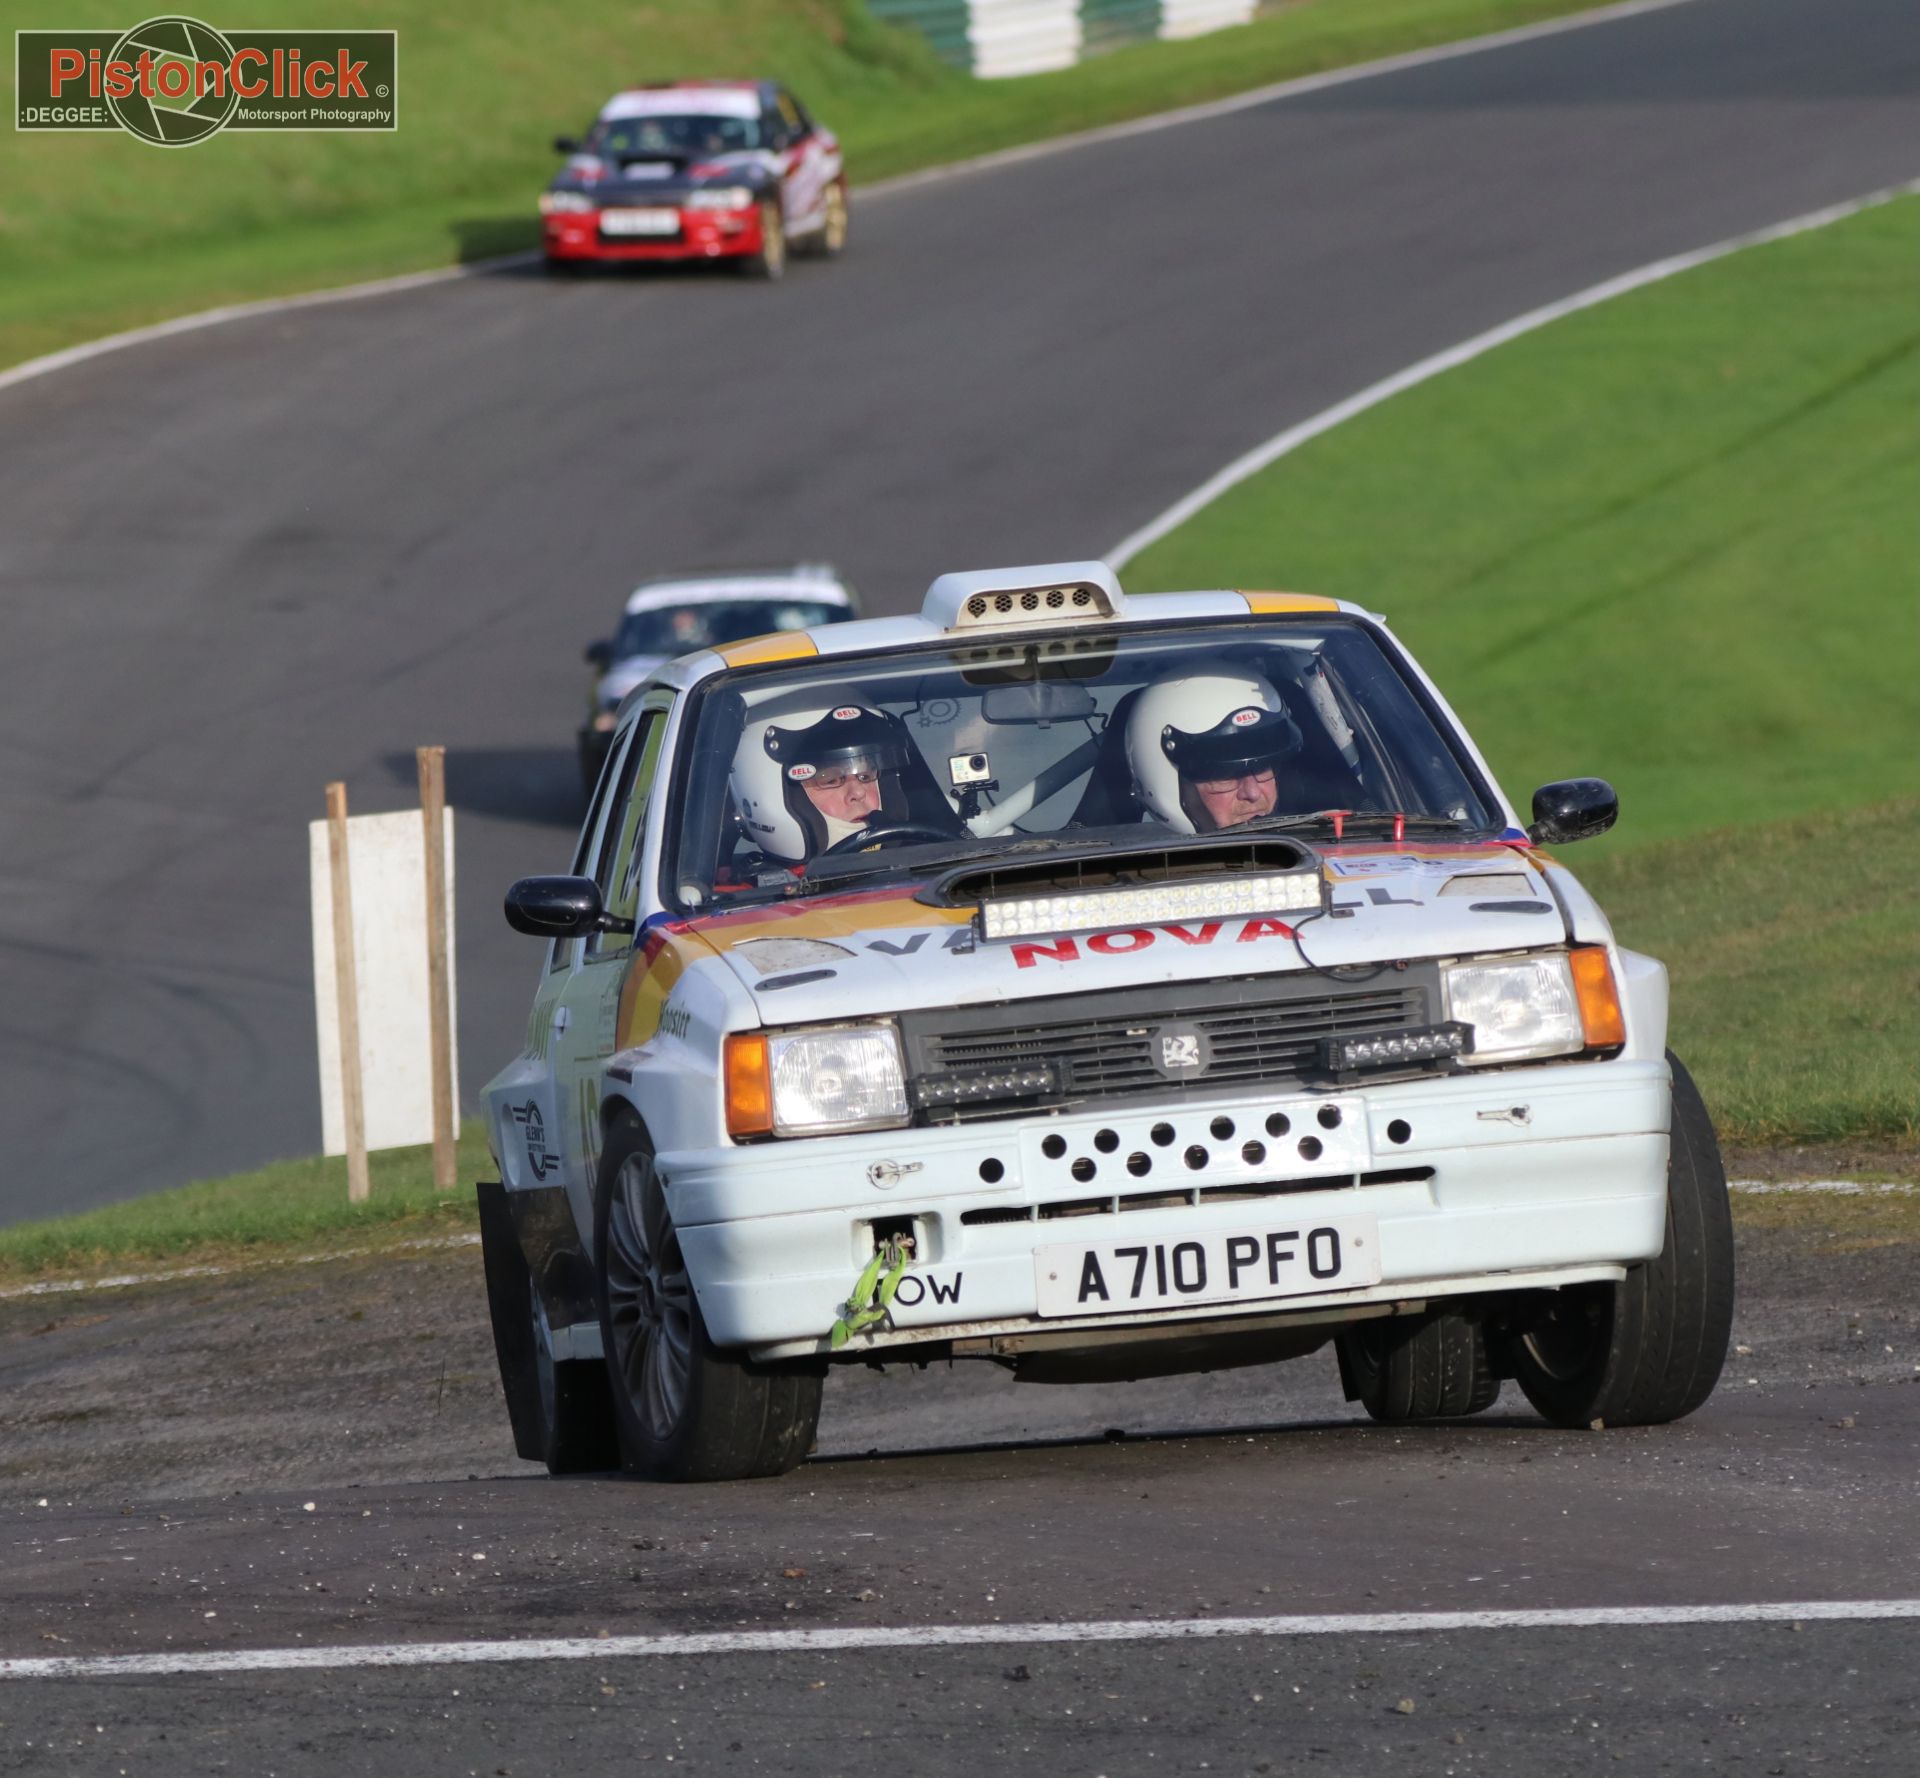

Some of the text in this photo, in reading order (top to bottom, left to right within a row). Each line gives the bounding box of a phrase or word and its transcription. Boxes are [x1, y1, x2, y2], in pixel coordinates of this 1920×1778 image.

[836, 709, 858, 718] BELL
[1236, 712, 1257, 722] BELL
[791, 768, 812, 776] BELL
[1009, 916, 1306, 969] NOVA
[1077, 1226, 1342, 1303] A710 PFO
